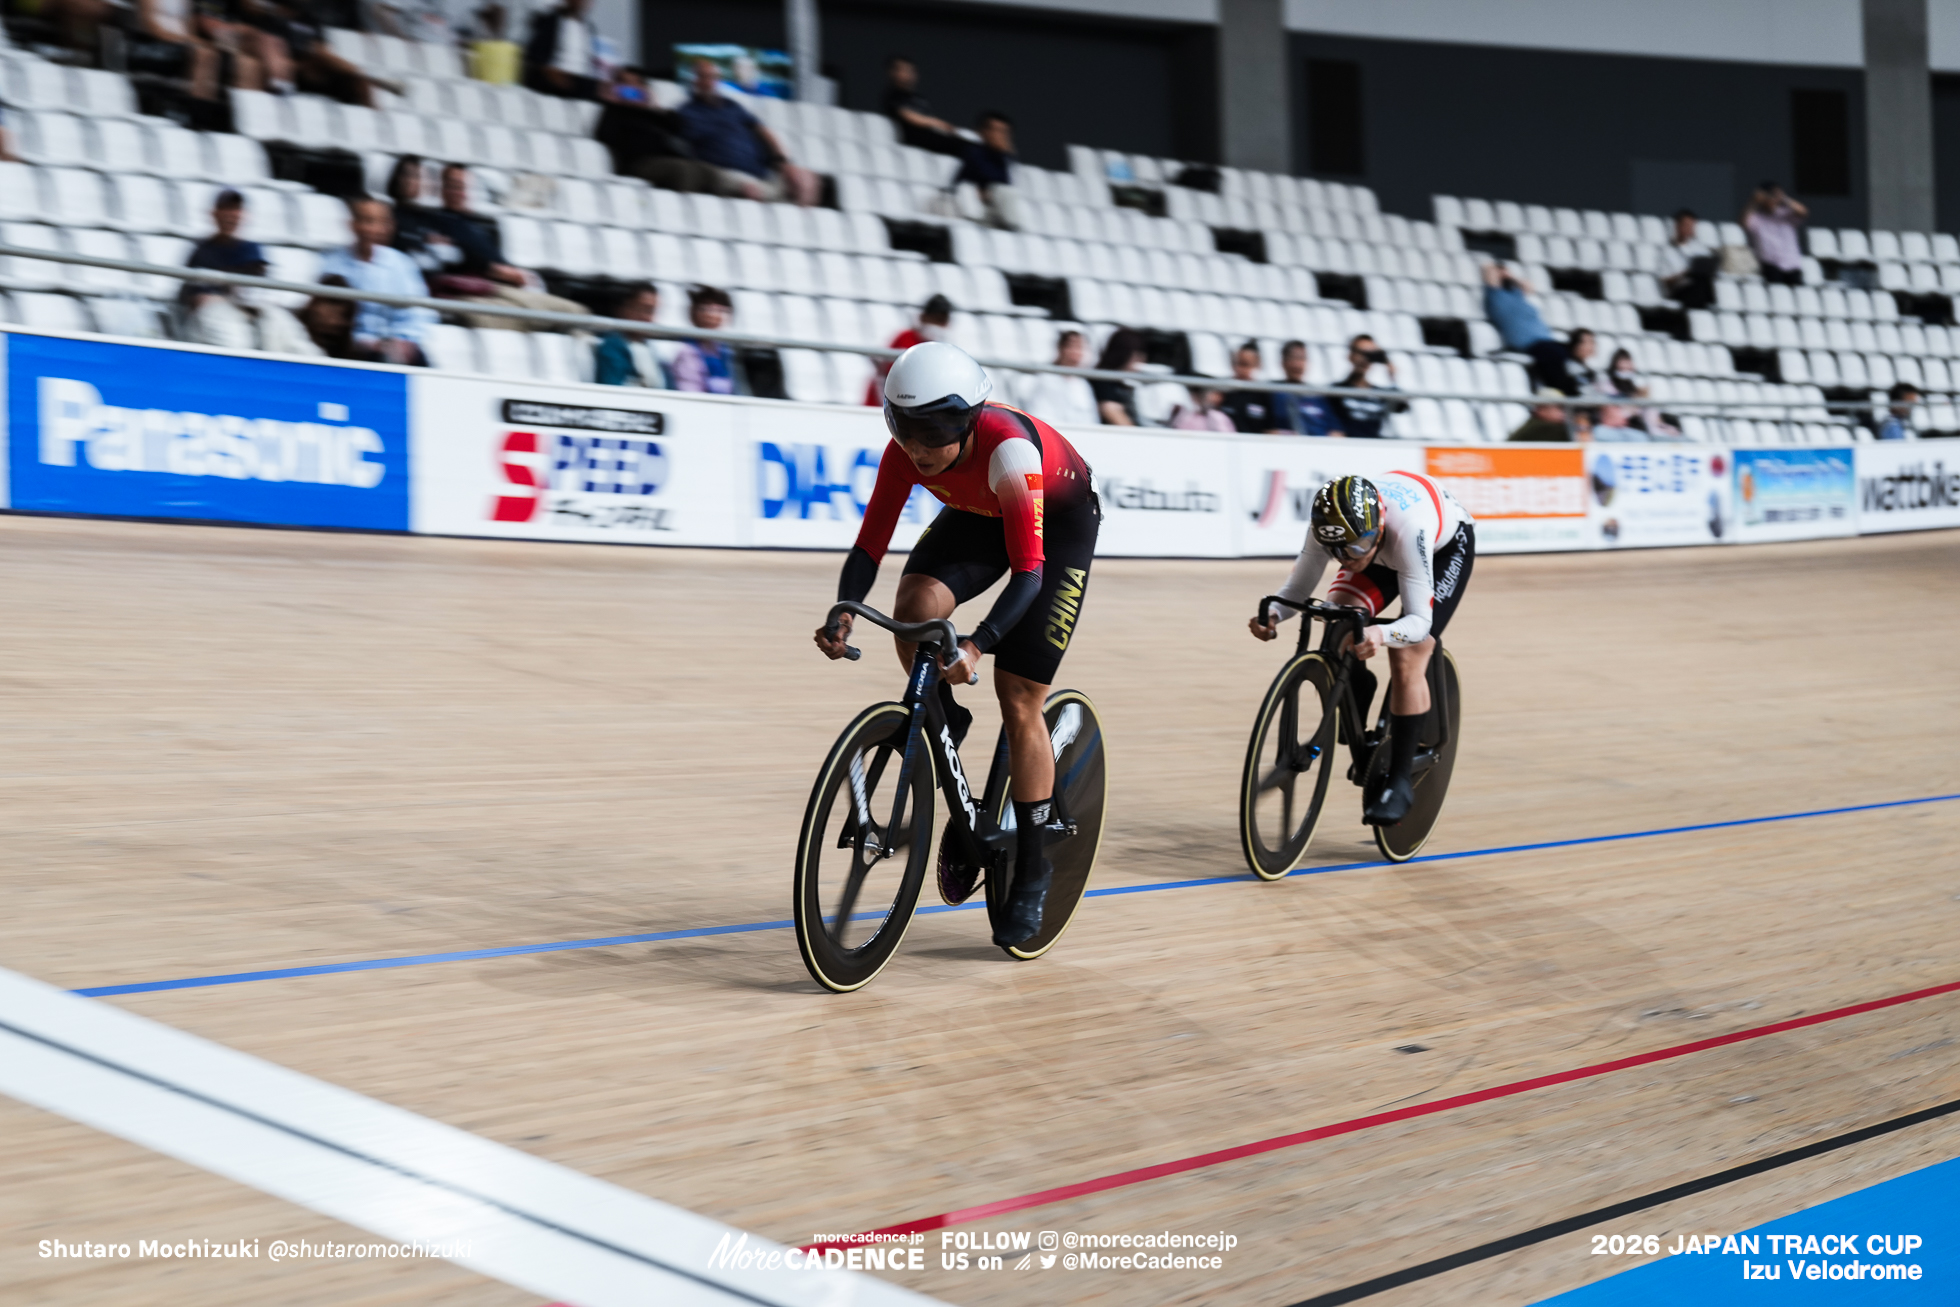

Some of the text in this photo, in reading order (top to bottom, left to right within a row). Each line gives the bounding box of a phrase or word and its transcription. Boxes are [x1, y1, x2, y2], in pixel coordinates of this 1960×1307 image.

[36, 376, 386, 490] Panasonic
[1044, 566, 1086, 651] CHINA
[916, 662, 929, 696] KOGA
[940, 724, 977, 831] KOGA
